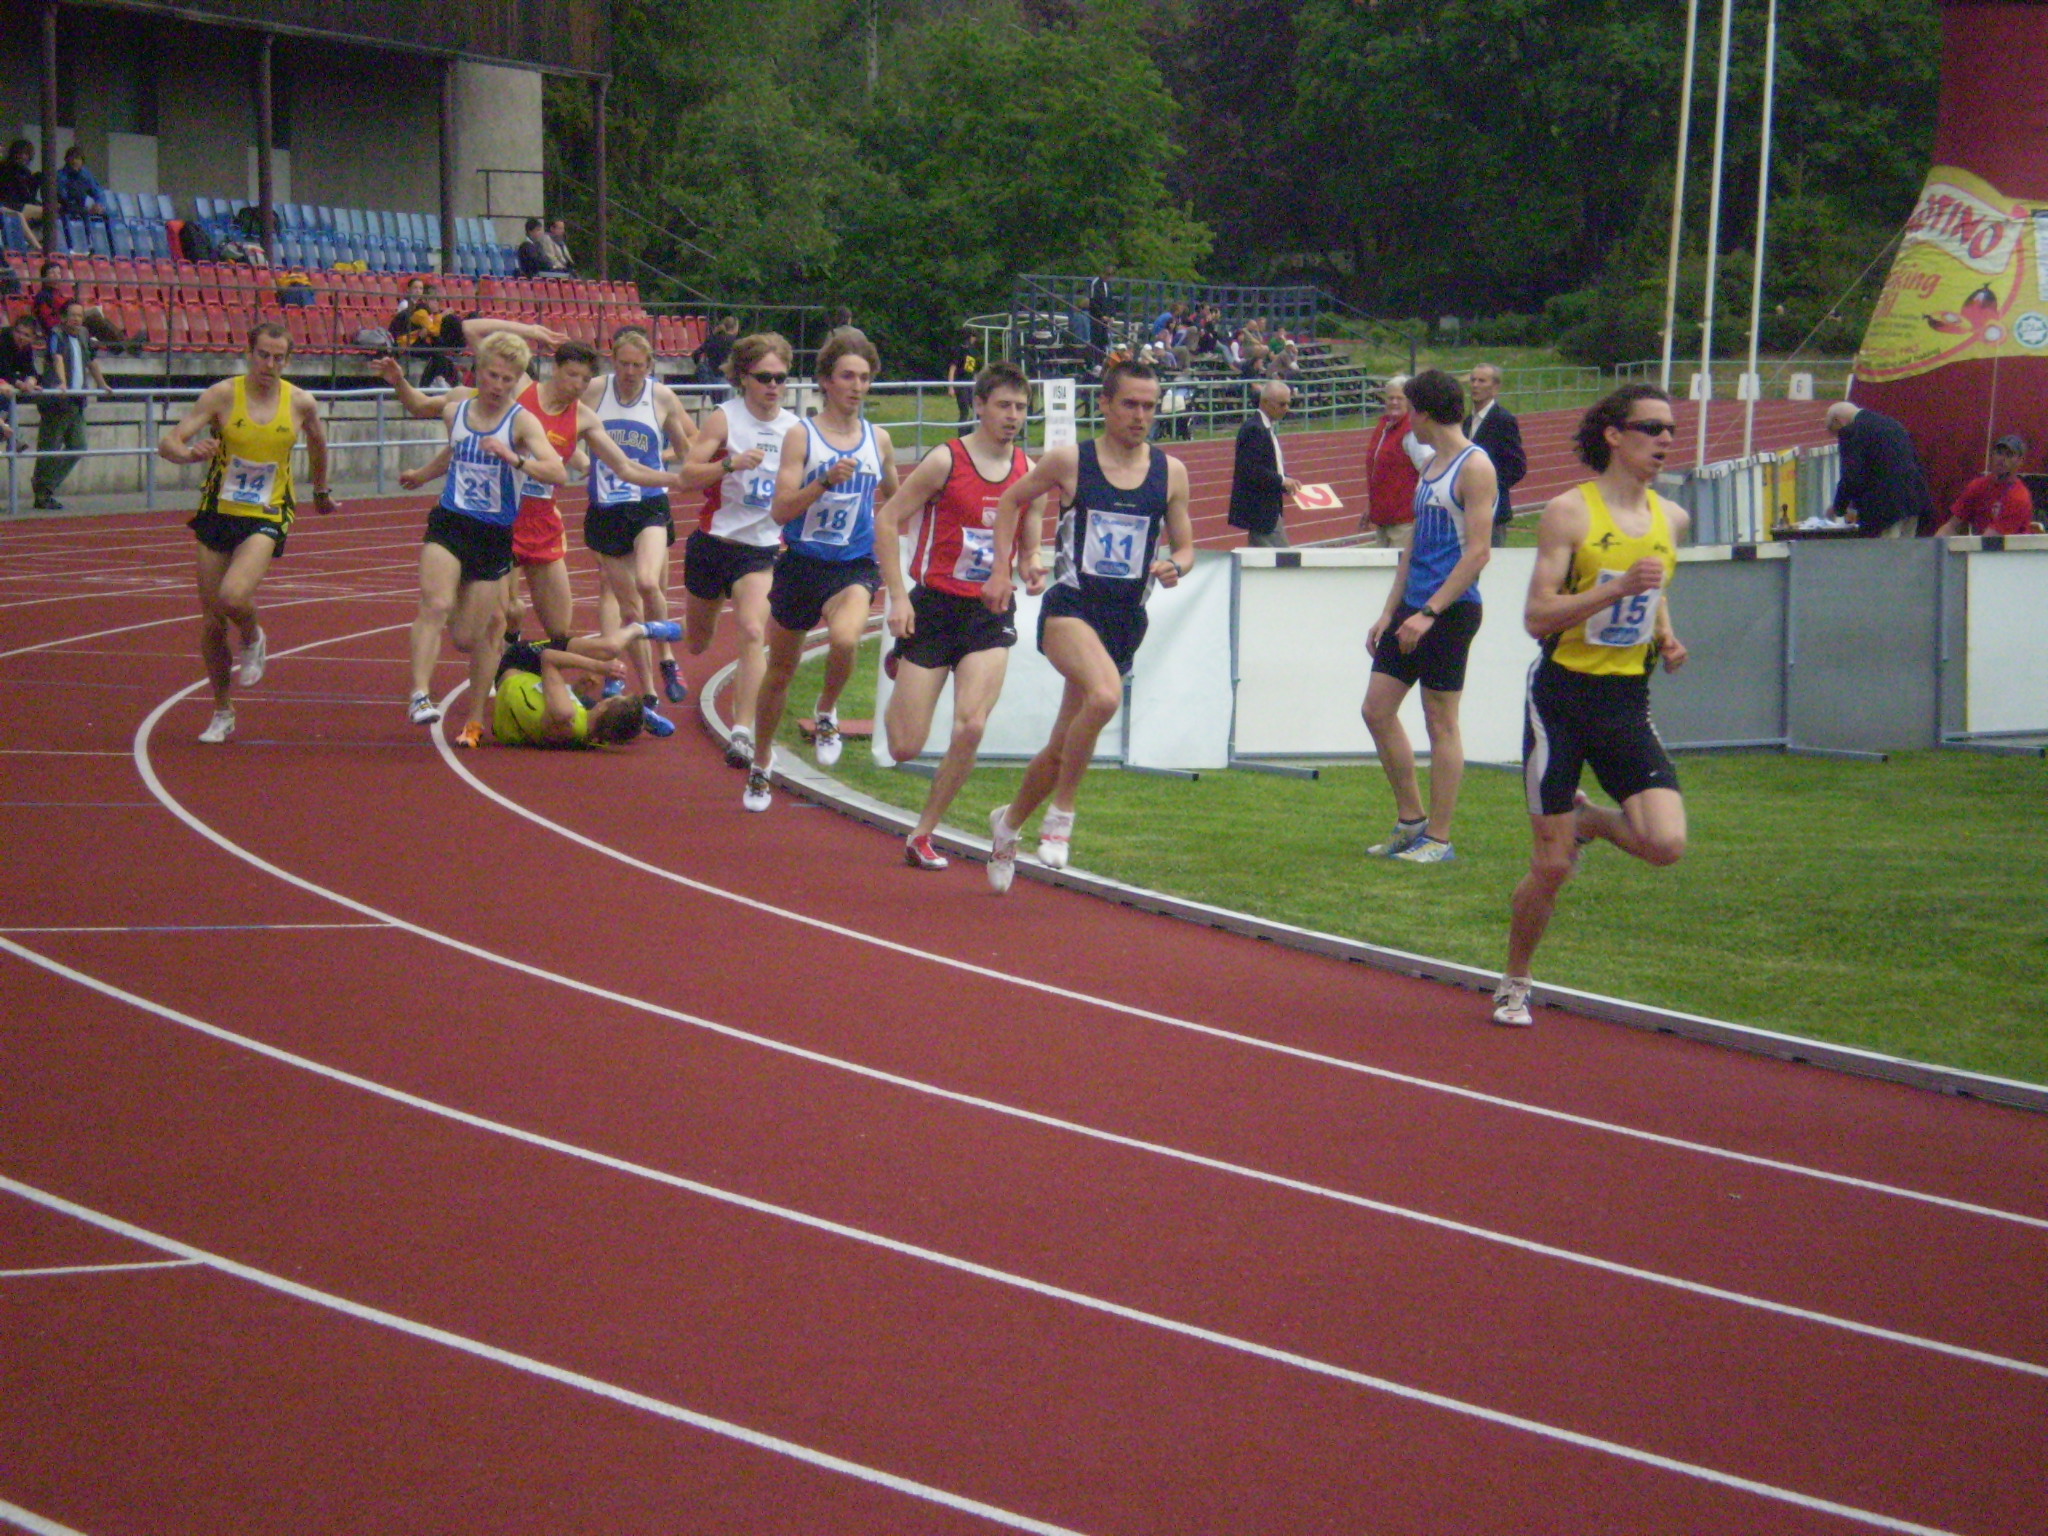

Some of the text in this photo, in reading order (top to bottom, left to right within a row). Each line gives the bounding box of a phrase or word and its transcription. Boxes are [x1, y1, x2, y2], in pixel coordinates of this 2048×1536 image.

[236, 473, 265, 491] 14
[464, 477, 491, 499] 21
[749, 476, 776, 499] 19
[1295, 486, 1333, 508] 2
[816, 508, 849, 531] 18
[971, 546, 994, 567] 1
[1100, 532, 1134, 561] 11
[1609, 594, 1650, 625] 15
